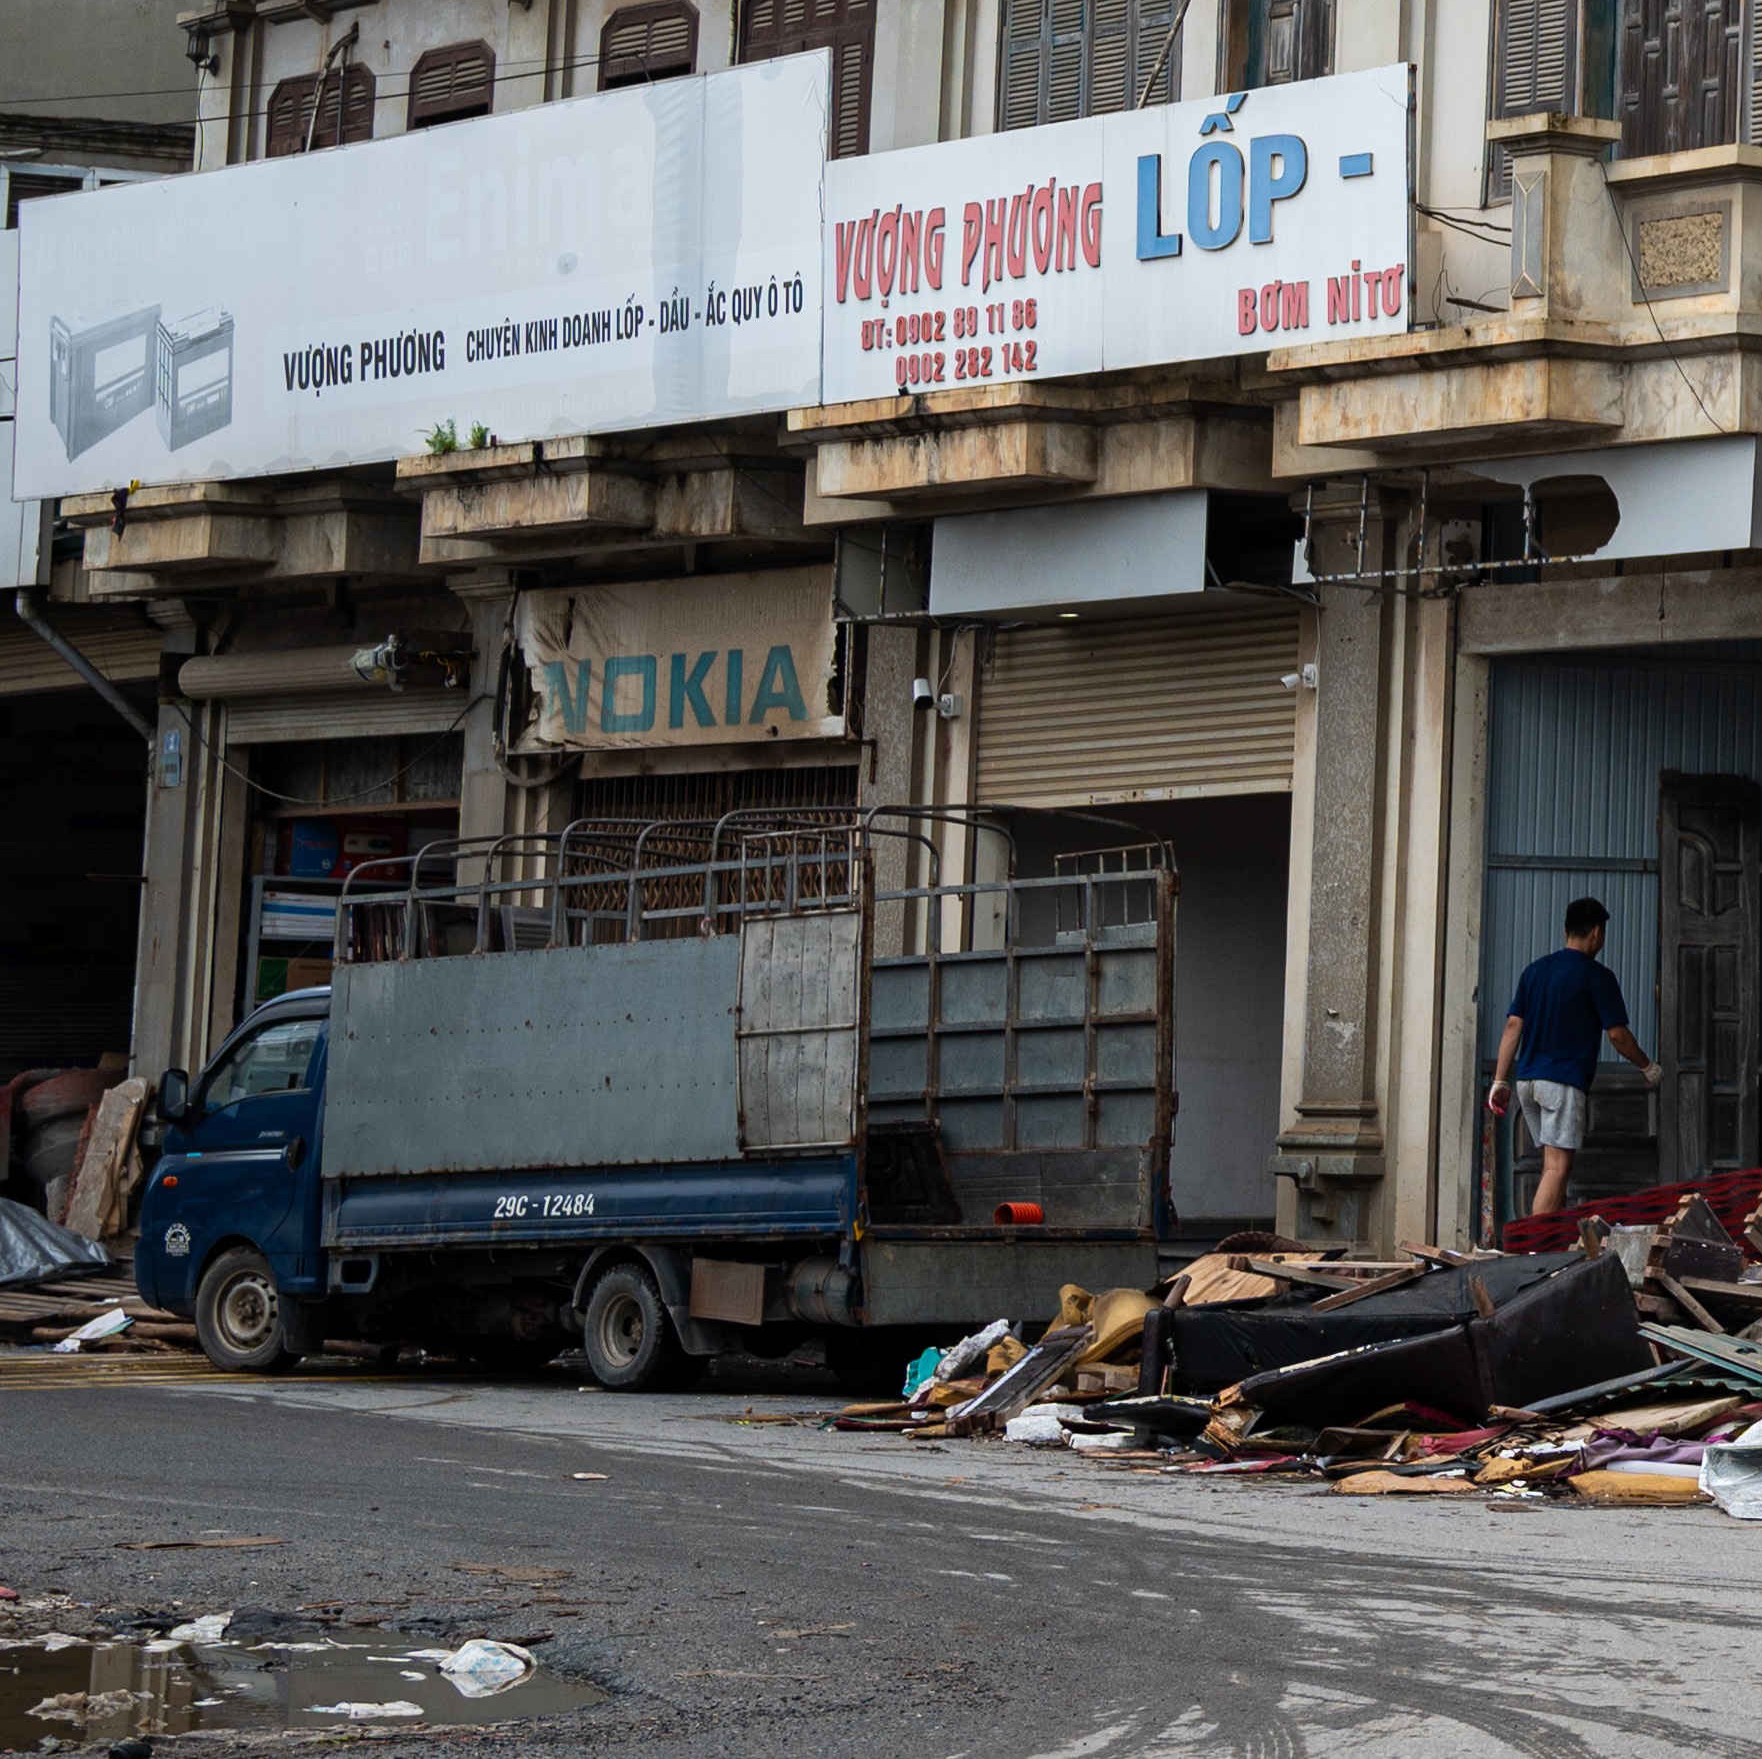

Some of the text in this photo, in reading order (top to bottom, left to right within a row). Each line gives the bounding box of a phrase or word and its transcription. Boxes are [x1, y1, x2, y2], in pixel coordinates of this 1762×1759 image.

[1136, 92, 1308, 261] LỐP
[834, 177, 1103, 309] VƯỢNG PHƯƠNG
[283, 343, 353, 397] VƯỢNG
[360, 328, 445, 382] PHƯƠNG
[466, 317, 521, 363] CHUYÊN
[525, 318, 558, 355] KINH
[562, 310, 612, 349] DOANH
[616, 293, 644, 341] LỐP
[660, 286, 690, 334] DẦU
[706, 280, 727, 327] ẮC
[732, 285, 764, 326] QUY
[767, 274, 778, 318] Ô
[783, 271, 804, 314] TÔ
[861, 298, 1038, 351] ĐT: 0902 89 11 86
[1238, 279, 1310, 336] BƠM
[895, 340, 1038, 386] 0902 282 142
[543, 644, 810, 734] NOKIA
